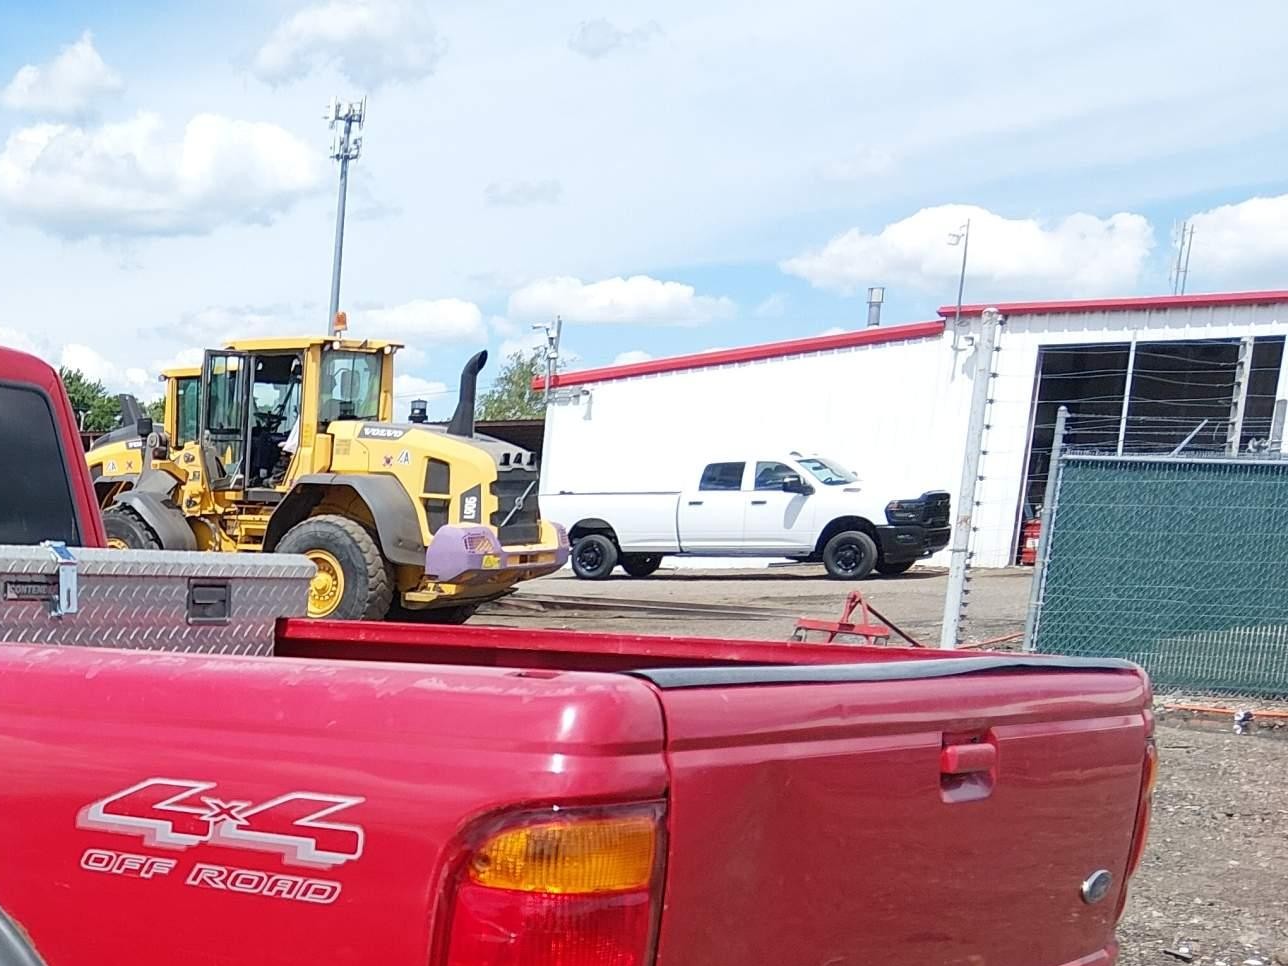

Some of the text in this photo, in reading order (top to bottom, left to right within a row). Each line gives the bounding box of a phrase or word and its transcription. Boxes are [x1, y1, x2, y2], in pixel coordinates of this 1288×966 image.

[363, 427, 404, 438] VOLVO
[80, 848, 341, 904] OFF ROAD
